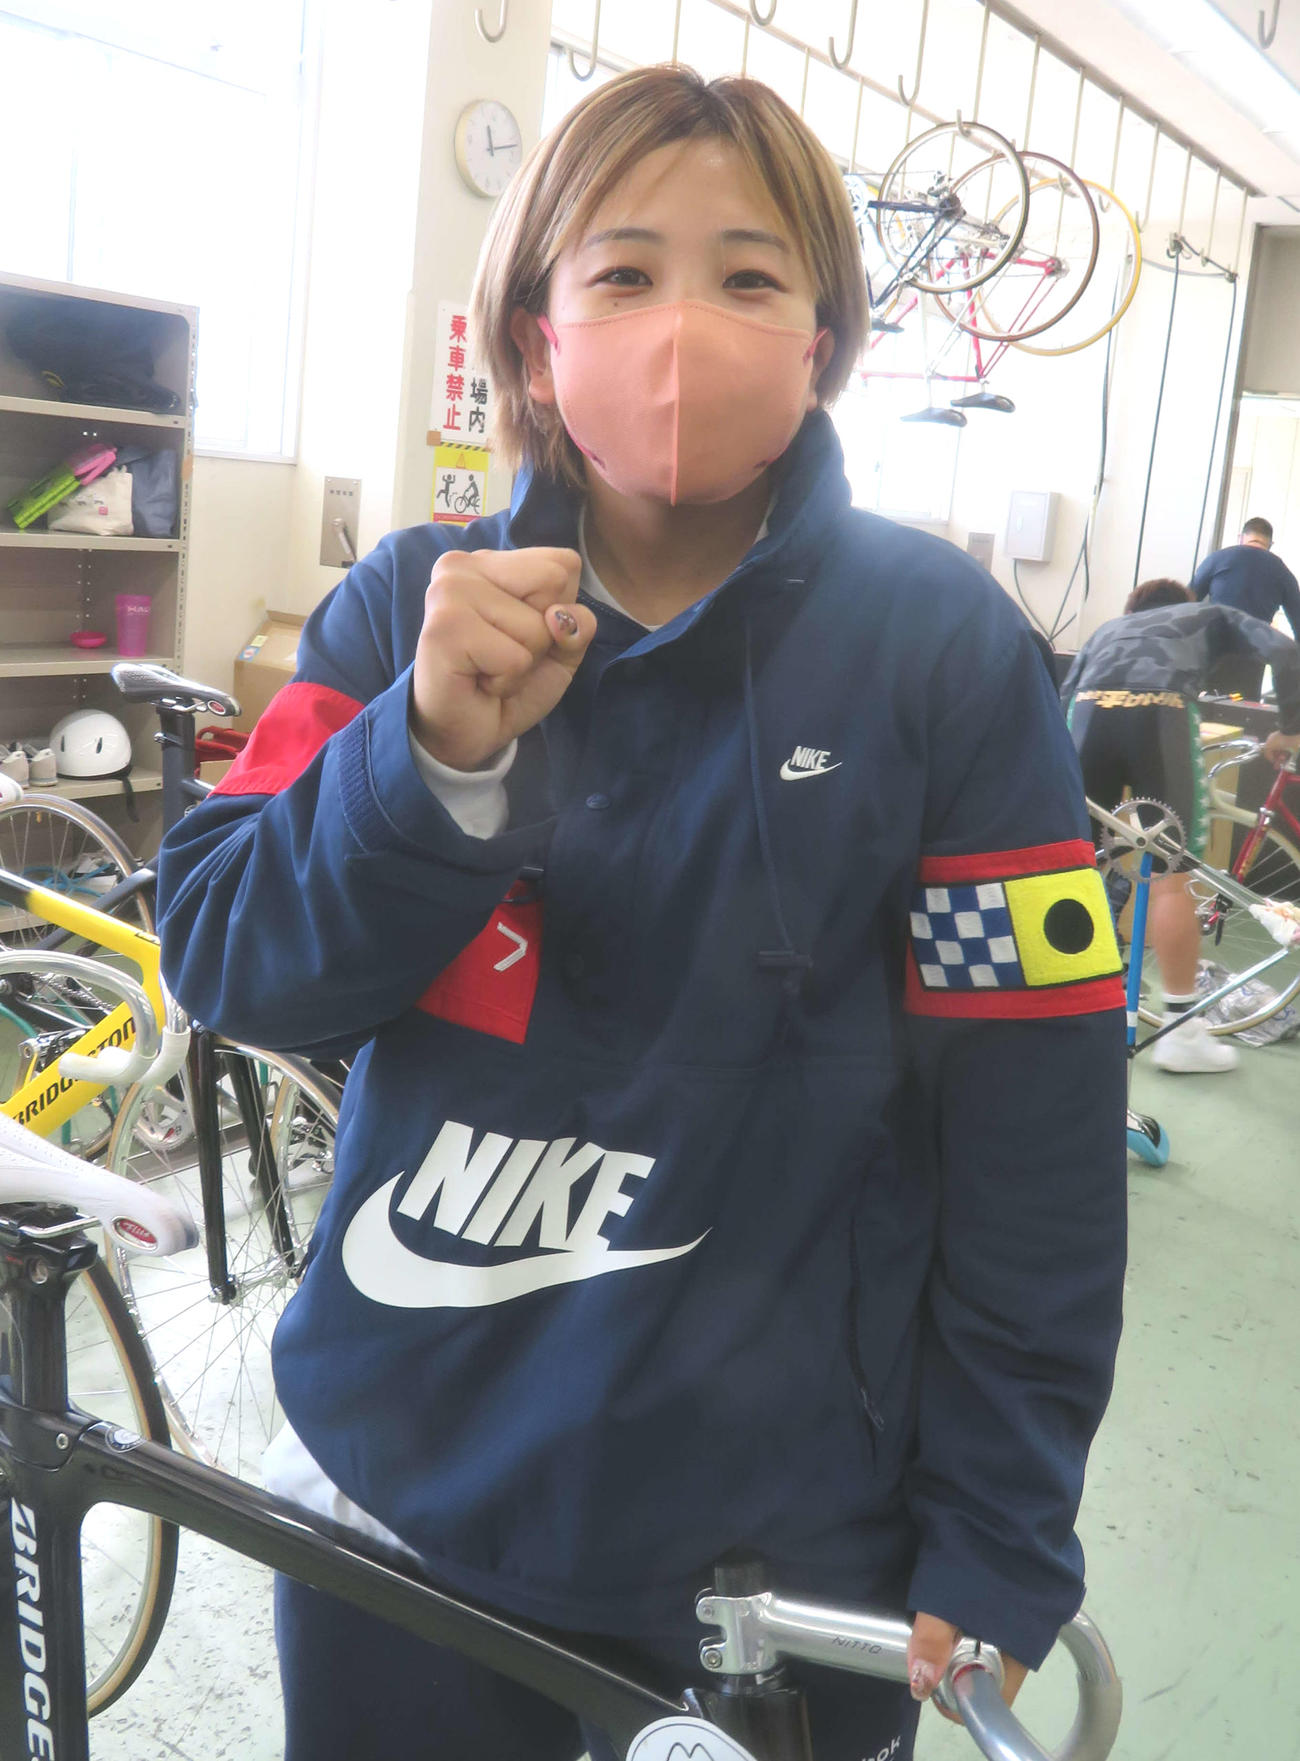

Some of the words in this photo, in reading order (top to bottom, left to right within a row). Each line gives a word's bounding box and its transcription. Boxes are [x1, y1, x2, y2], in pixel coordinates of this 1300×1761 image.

[443, 313, 468, 431] 乗車禁止
[790, 745, 832, 770] NIKE
[397, 1120, 656, 1252] NIKE
[10, 1496, 56, 1761] BRIDGE
[832, 1636, 882, 1655] NITTO
